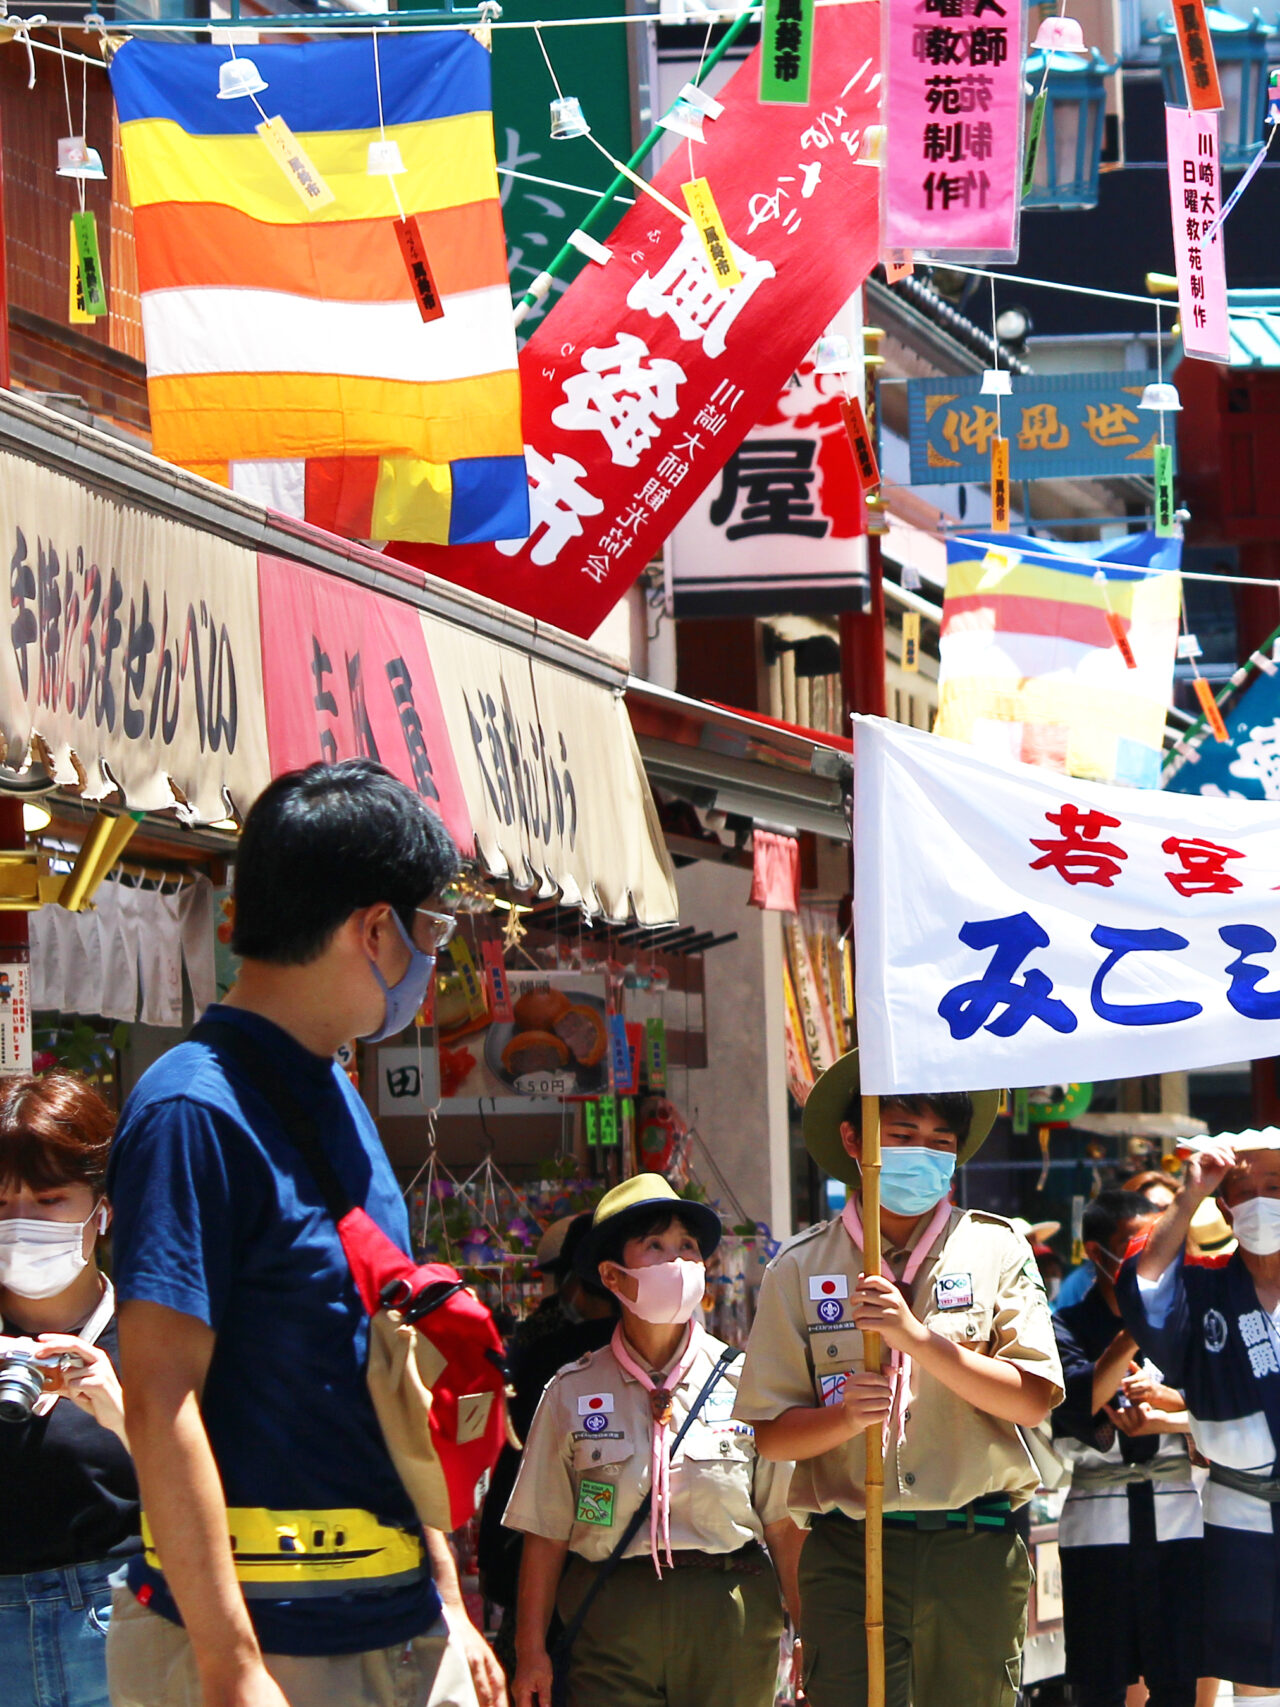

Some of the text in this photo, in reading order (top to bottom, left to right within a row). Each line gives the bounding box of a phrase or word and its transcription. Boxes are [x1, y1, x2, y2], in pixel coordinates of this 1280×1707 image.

[1183, 160, 1207, 329] 日曜教苑制作
[943, 402, 1142, 453] 仲見世
